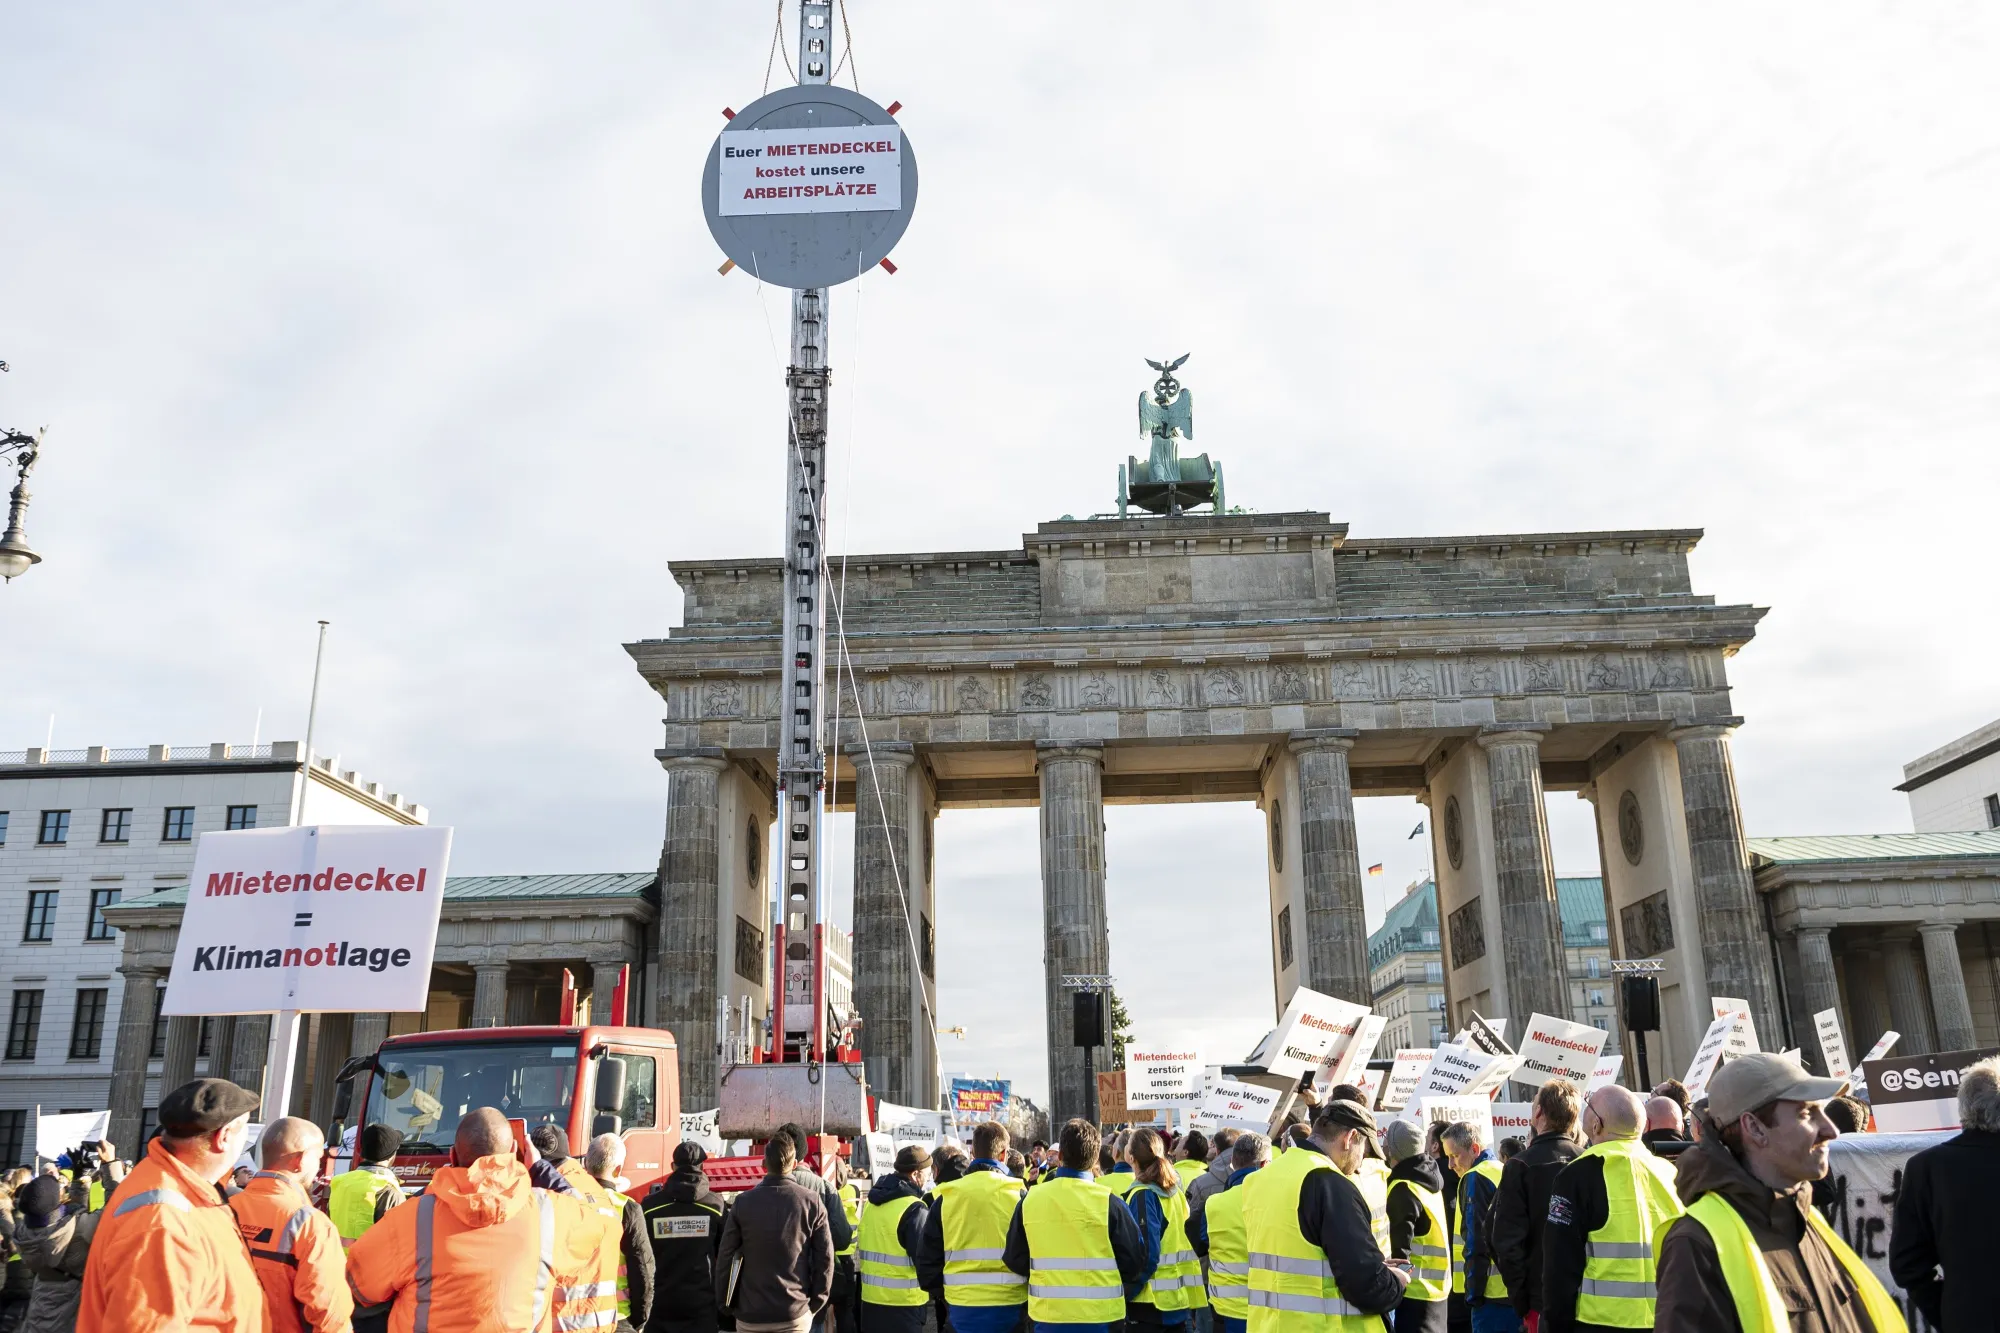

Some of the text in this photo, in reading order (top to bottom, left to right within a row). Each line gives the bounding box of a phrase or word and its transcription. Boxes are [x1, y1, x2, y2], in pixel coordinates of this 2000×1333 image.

[725, 141, 896, 158] Euer MIETENDECKEL
[756, 164, 865, 178] kostet unsere
[743, 182, 877, 200] ARBEITSPLÄTZE
[205, 867, 427, 897] Mietendeckel
[193, 941, 411, 972] Klimanotlage
[1532, 1031, 1598, 1054] Mietendeckel
[1134, 1052, 1197, 1062] Mietendeckel
[1284, 1045, 1339, 1068] Klimanotlage
[1444, 1054, 1481, 1072] Häuser
[1147, 1065, 1185, 1074] zerstört
[1432, 1067, 1471, 1085] brauche
[1523, 1058, 1587, 1081] Klimanotlage
[1150, 1079, 1183, 1087] unsere
[1881, 1066, 1961, 1092] @Sen
[1131, 1090, 1202, 1101] Altersvorsorge!
[1215, 1087, 1240, 1098] Neue
[1242, 1091, 1270, 1105] Wege
[1228, 1101, 1244, 1111] für
